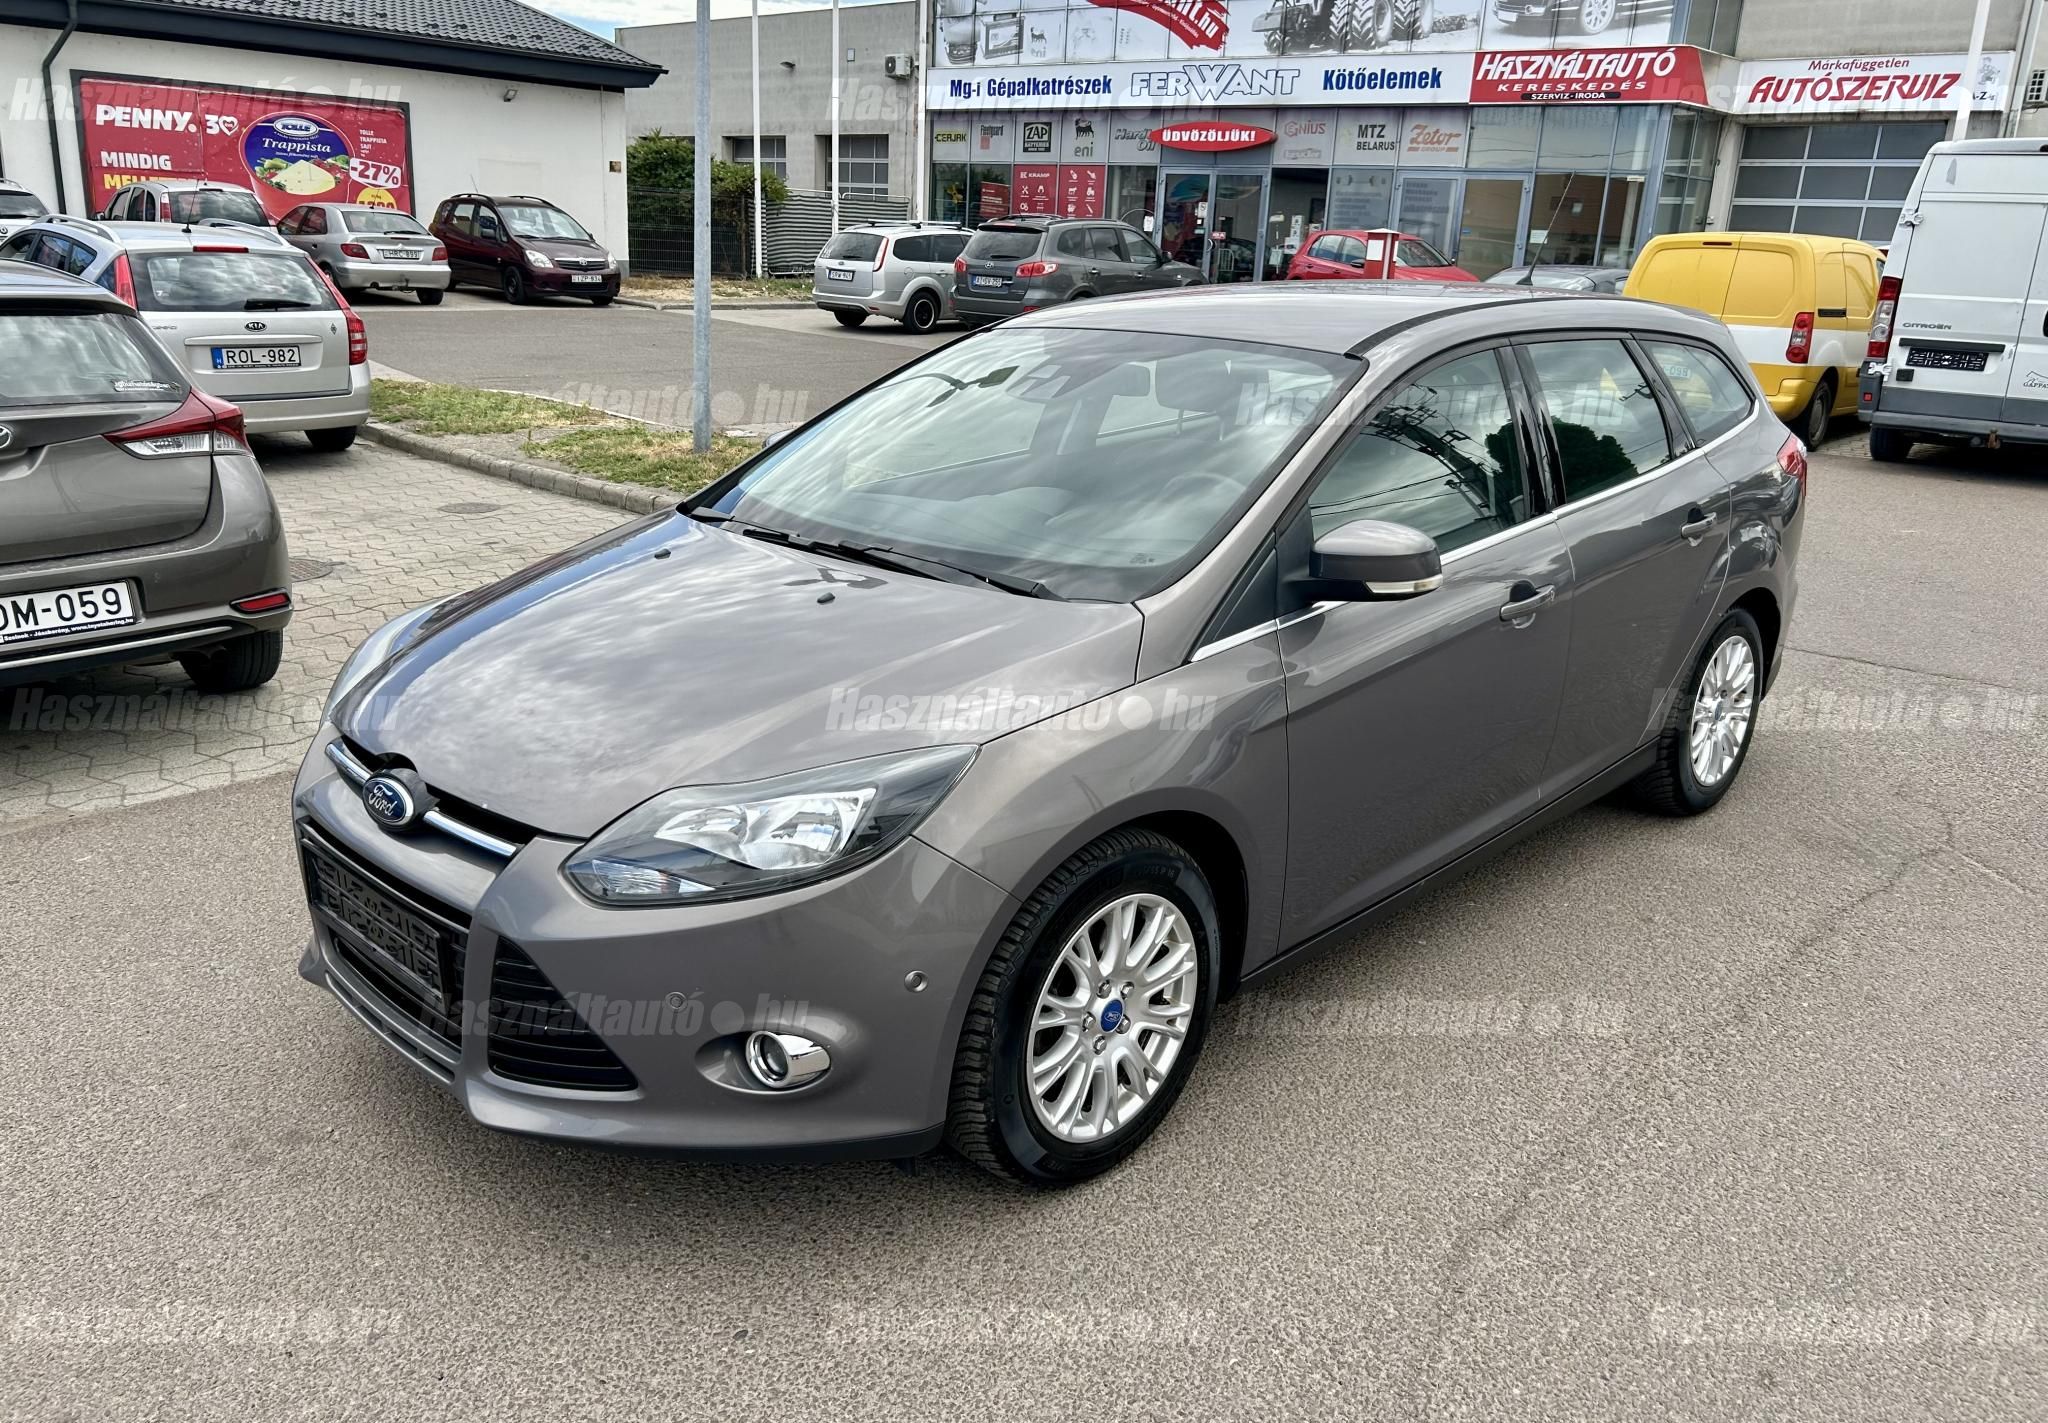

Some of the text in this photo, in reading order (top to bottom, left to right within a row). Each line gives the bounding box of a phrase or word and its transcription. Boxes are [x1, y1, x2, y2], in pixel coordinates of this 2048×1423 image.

[1476, 48, 1676, 80] HASZNÁLTAUTÓ
[1808, 58, 1910, 72] Márkafüggetlen
[1130, 64, 1300, 101] FERWANT
[1322, 66, 1442, 91] Kötőelemek
[1497, 80, 1647, 92] KERESKEDÉS
[950, 75, 1112, 99] Mg-i Gépalkatrészek
[1748, 72, 1961, 105] AUTÓSZERVIZ
[1026, 125, 1048, 140] ZAP
[1162, 129, 1256, 142] ÜDVÖZÖLJÜK!
[1358, 124, 1386, 138] MTZ
[1409, 123, 1462, 146] Zetor
[262, 137, 332, 153] Trappista
[1074, 142, 1093, 157] eni
[1356, 141, 1396, 151] BELARUS
[100, 151, 172, 171] MINDIG
[350, 160, 399, 185] -27%
[248, 322, 265, 330] KIA
[1902, 321, 1952, 330] CITROËN
[226, 349, 296, 364] ROL-982
[369, 784, 399, 817] Ford
